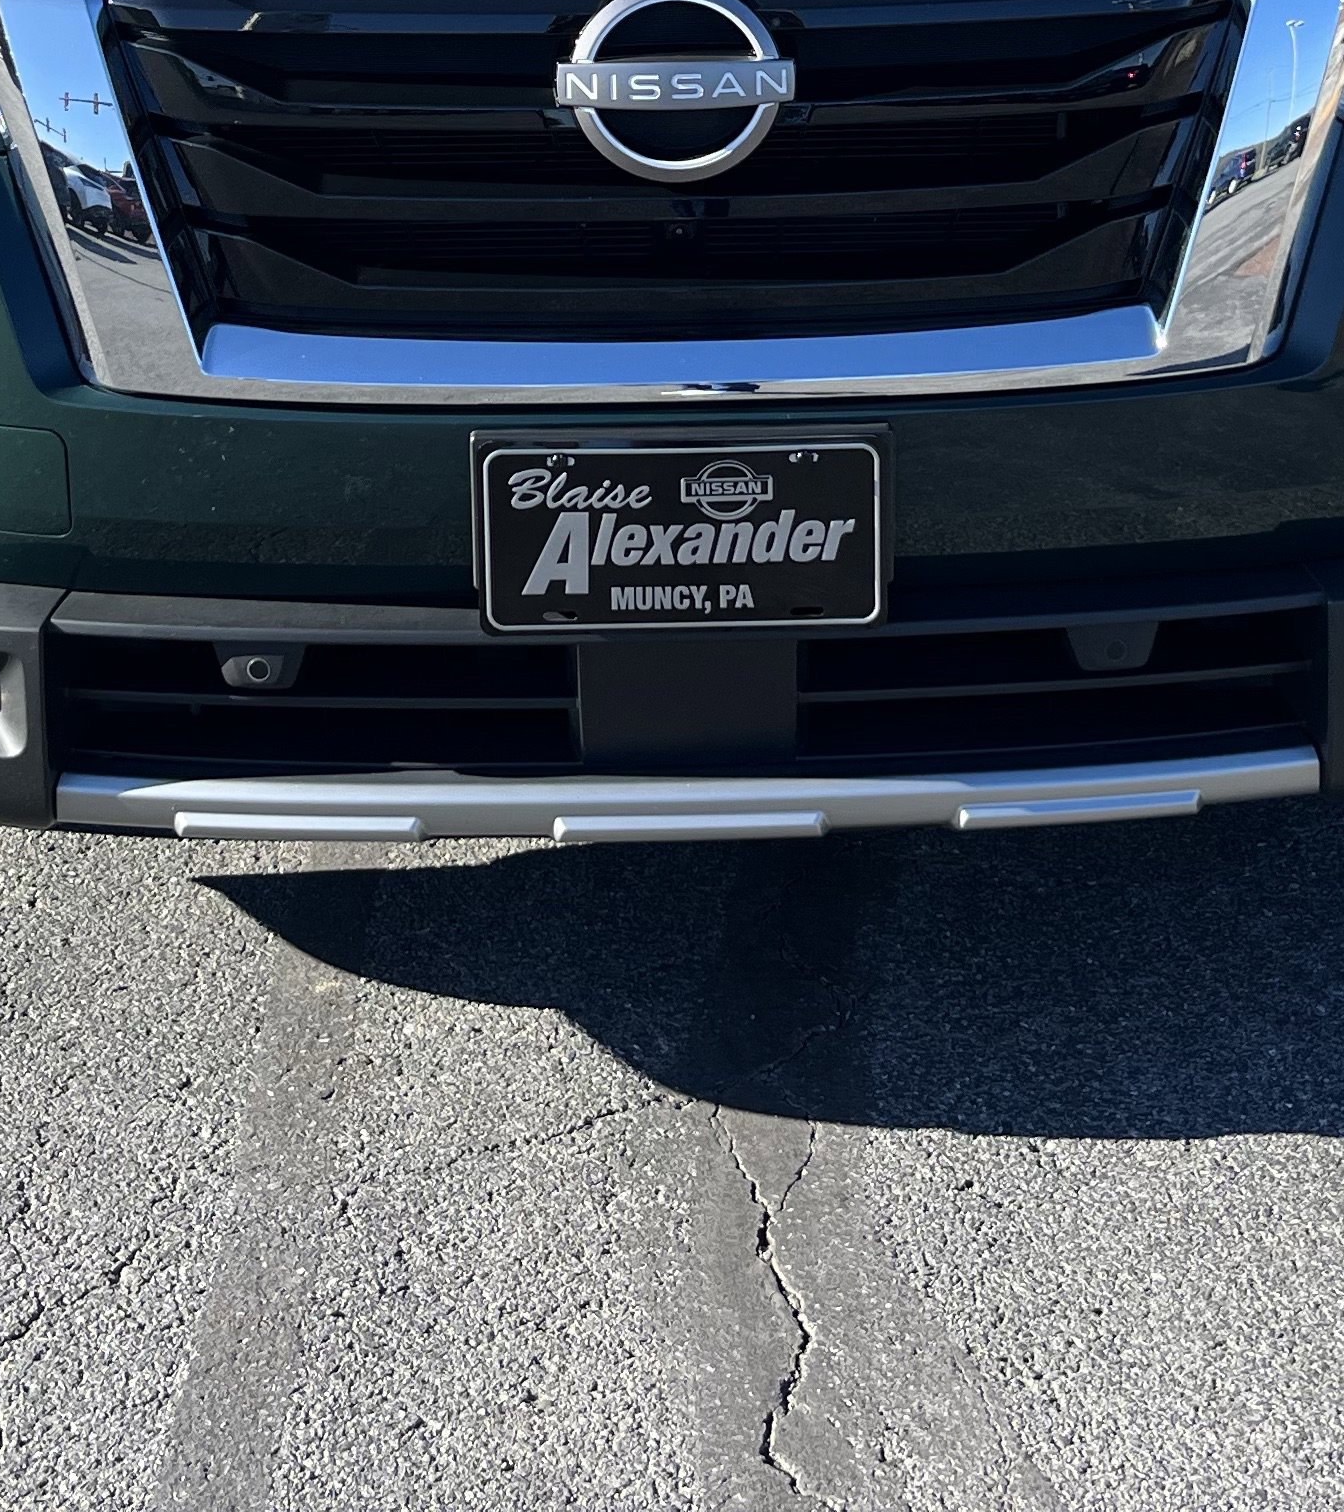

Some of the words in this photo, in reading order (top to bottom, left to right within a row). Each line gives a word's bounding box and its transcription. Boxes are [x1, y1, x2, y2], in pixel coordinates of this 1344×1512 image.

[565, 68, 788, 101] NISSAN
[508, 468, 653, 510] Blaise
[690, 480, 762, 497] NISSAN
[521, 509, 856, 596] Alexander
[610, 584, 712, 614] MUNCY,
[719, 584, 755, 609] PA
